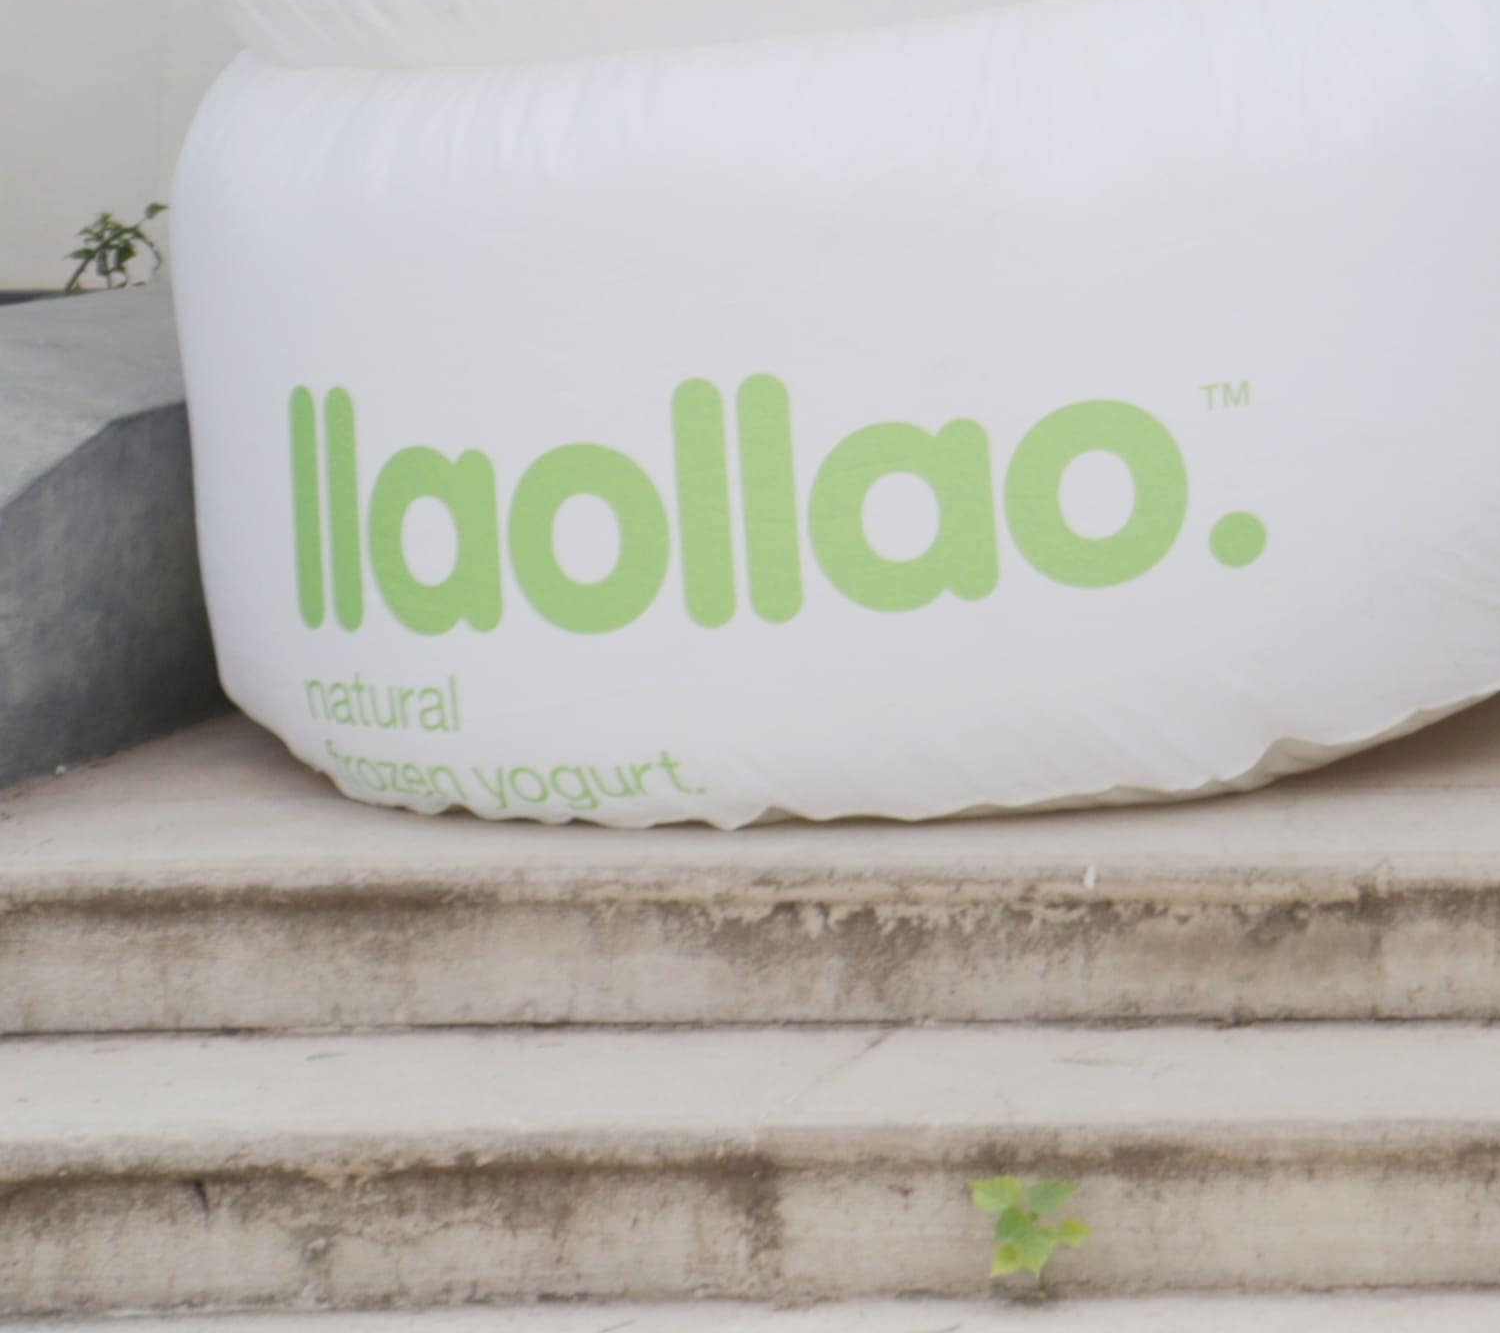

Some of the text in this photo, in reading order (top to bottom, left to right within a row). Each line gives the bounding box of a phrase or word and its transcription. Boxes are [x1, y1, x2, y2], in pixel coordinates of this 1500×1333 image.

[303, 671, 462, 732] natural
[324, 738, 707, 810] frozen yogurt.
